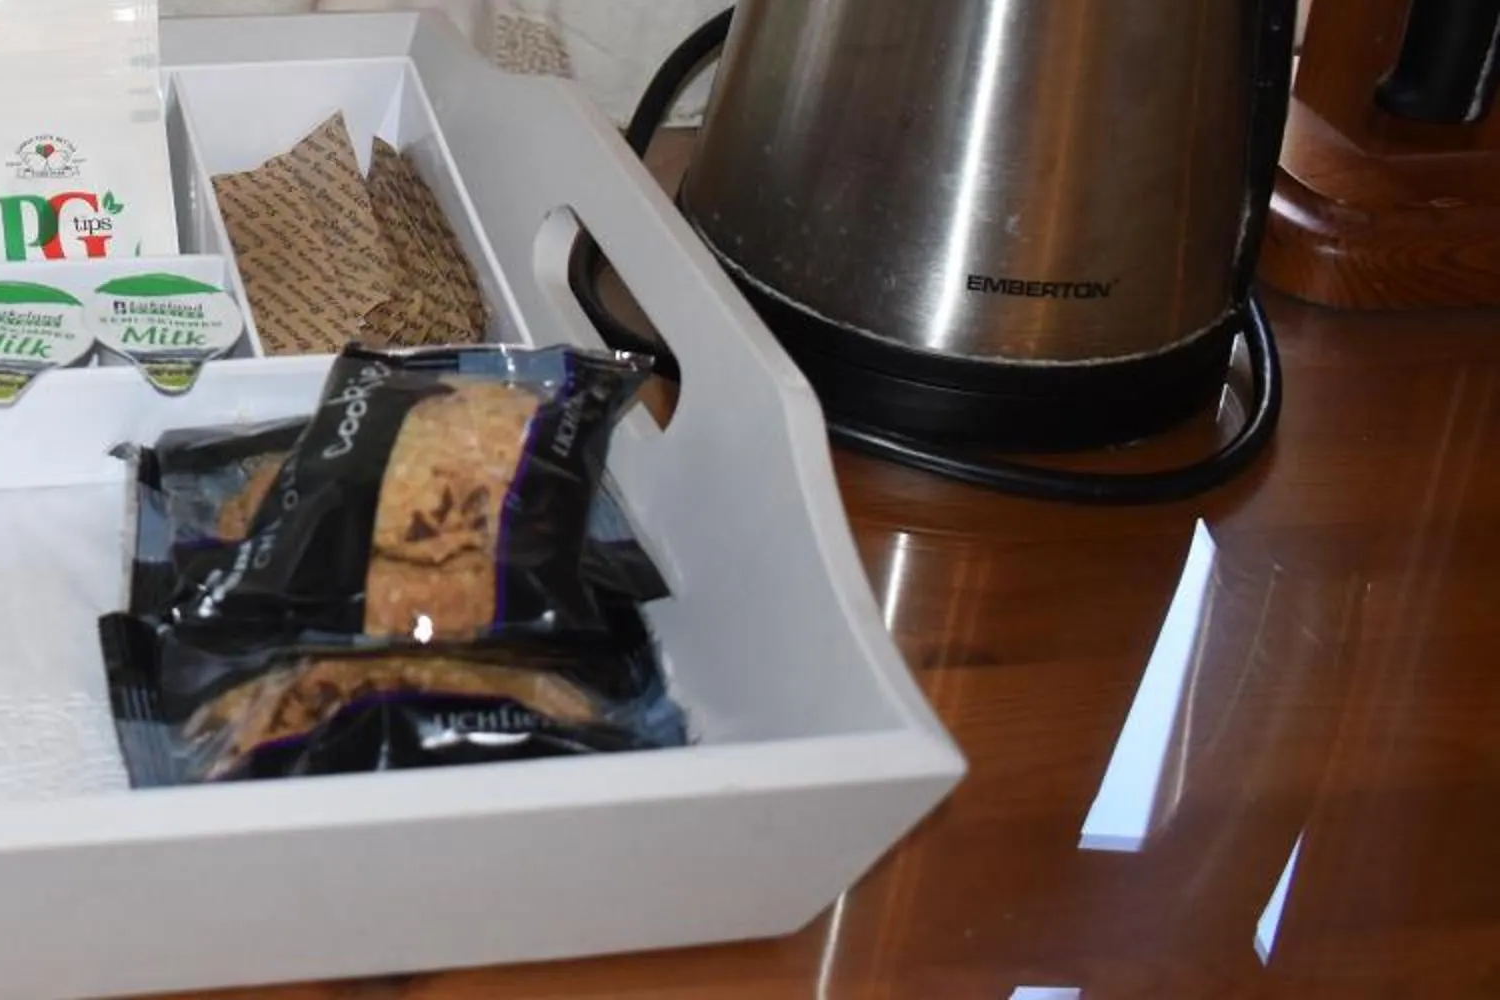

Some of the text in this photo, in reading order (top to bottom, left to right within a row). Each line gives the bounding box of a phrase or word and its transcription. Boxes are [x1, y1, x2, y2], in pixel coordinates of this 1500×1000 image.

[72, 217, 114, 235] tips
[966, 274, 1112, 299] EMBERTON
[121, 325, 208, 346] Milk
